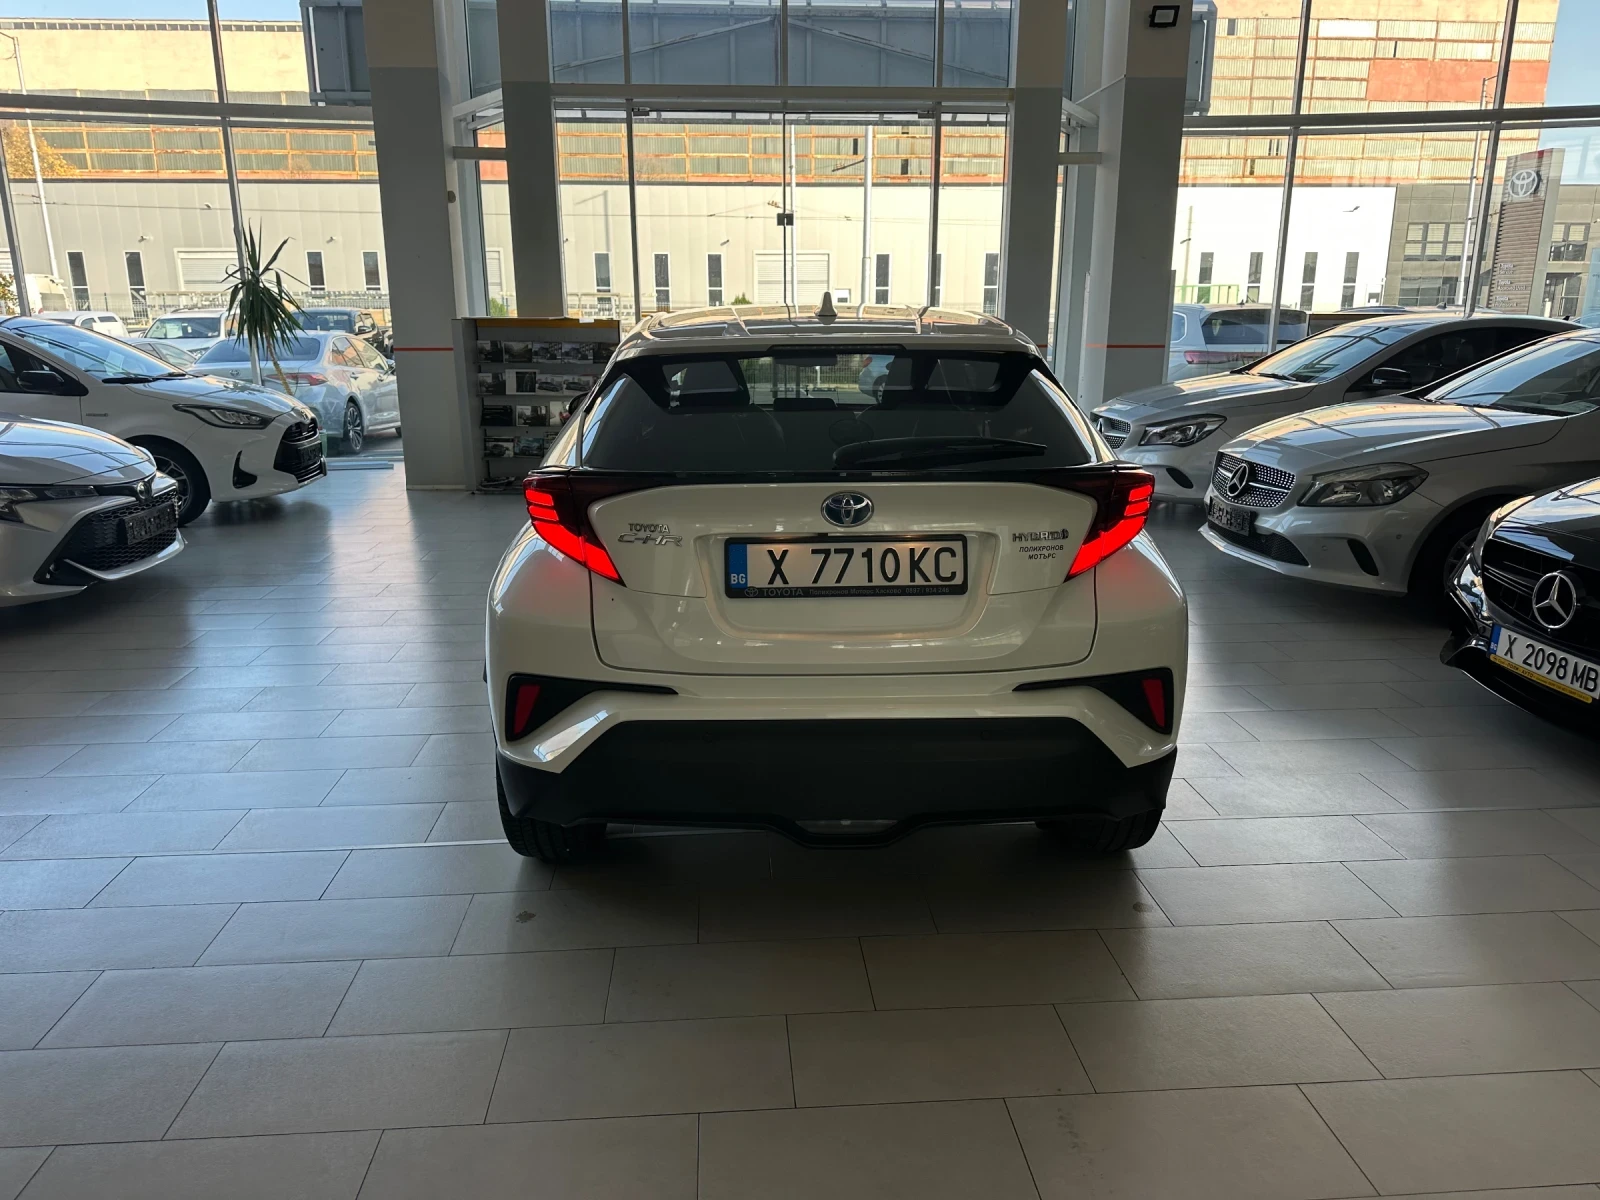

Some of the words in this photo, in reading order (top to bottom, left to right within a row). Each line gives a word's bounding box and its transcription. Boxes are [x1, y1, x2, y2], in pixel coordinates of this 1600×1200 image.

[628, 523, 670, 533] TOYOTA
[617, 532, 683, 547] C-HR
[1012, 531, 1062, 542] HYBRID
[1018, 544, 1064, 553] ПОЛИХРОНОВ
[1028, 552, 1057, 560] МОТЪРС
[730, 573, 746, 585] BG
[763, 587, 804, 597] TOYOTA
[1522, 643, 1569, 680] 2098
